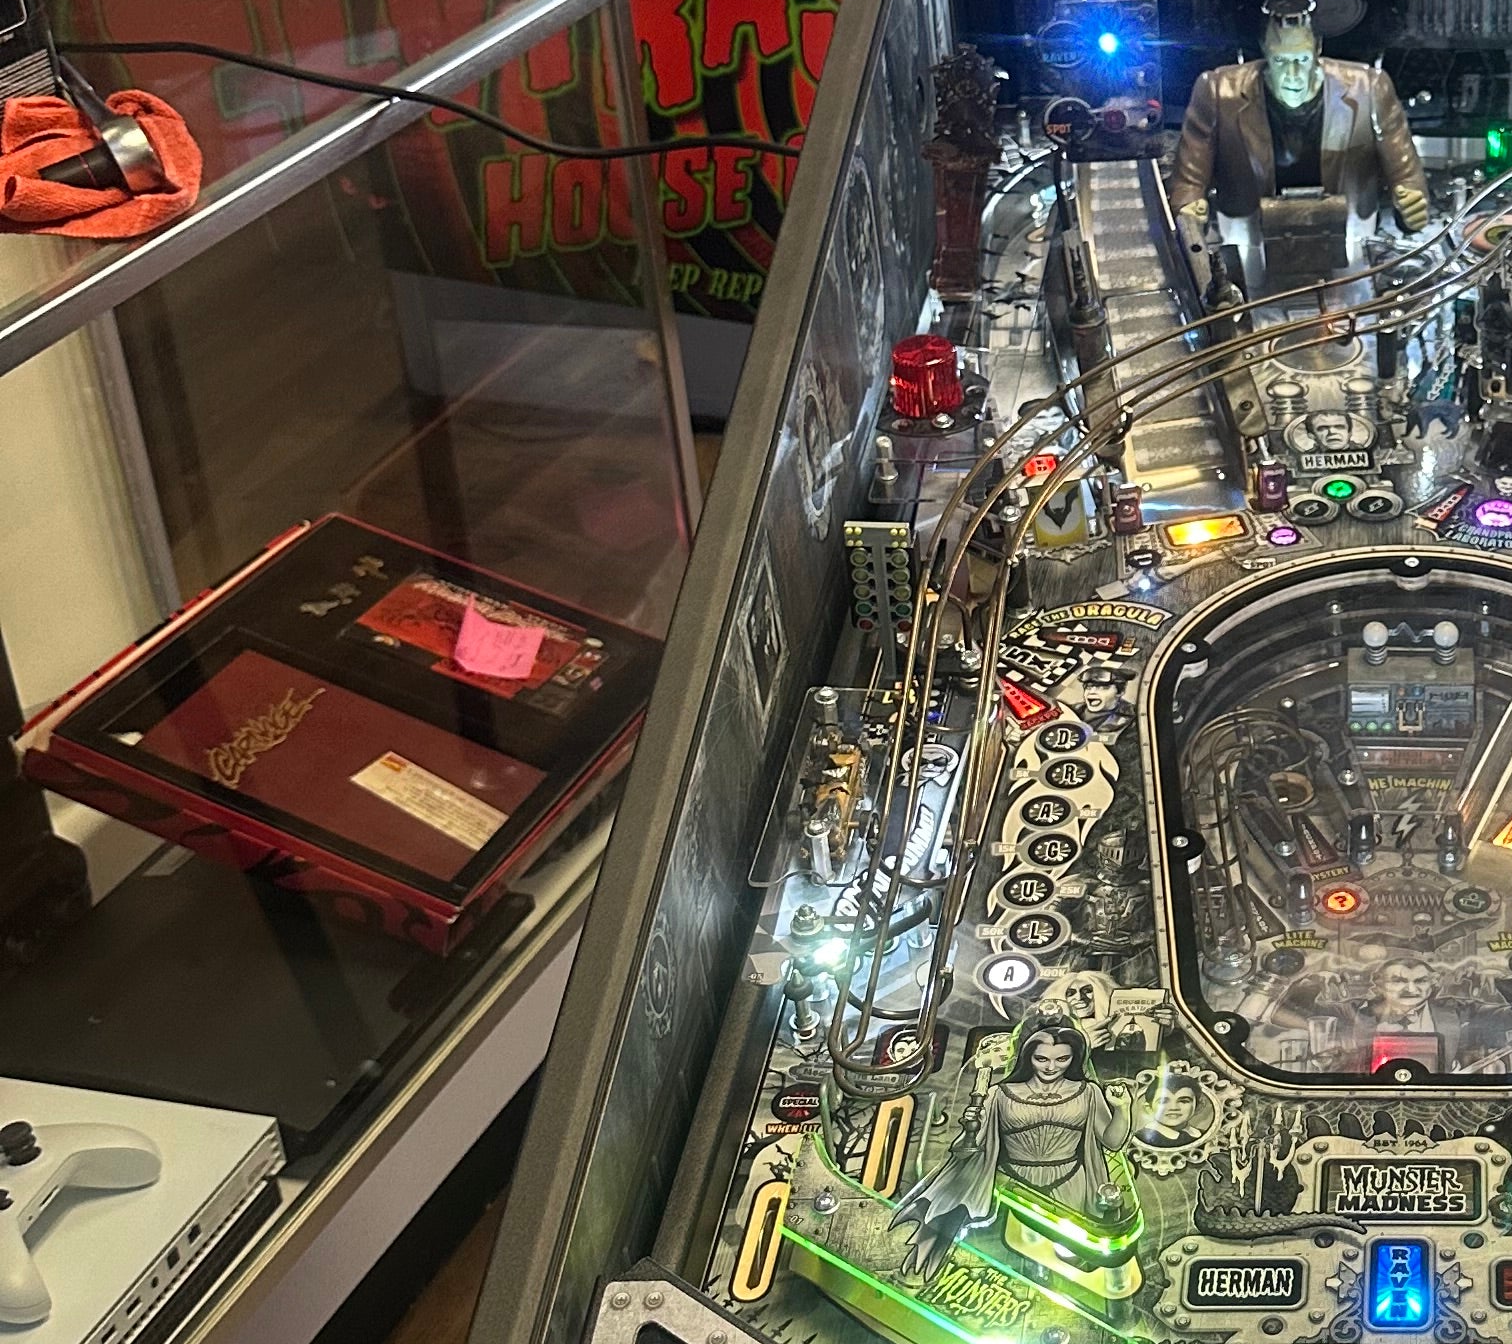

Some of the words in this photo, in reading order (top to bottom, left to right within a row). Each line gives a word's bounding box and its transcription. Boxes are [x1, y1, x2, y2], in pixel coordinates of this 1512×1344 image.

[484, 145, 755, 266] HOUSE
[1303, 452, 1369, 469] HERMAN
[1042, 611, 1071, 624] THE
[205, 688, 326, 790] CARNAGE
[1057, 729, 1070, 748] D
[1064, 763, 1078, 785] R
[1037, 802, 1056, 822] A
[1047, 840, 1061, 862] G
[1021, 880, 1039, 900] U
[1029, 920, 1045, 942] L
[1285, 929, 1315, 941] LITE
[1273, 938, 1328, 951] MACHINE
[1003, 965, 1016, 984] A
[779, 1096, 820, 1109] SPECIAL
[766, 1124, 798, 1135] WHEN
[800, 1123, 820, 1134] LIT
[1340, 1164, 1463, 1197] MUNSTER
[1336, 1193, 1467, 1214] MADNESS
[984, 1267, 1009, 1286] THE
[1198, 1267, 1294, 1297] HERMAN
[930, 1262, 1031, 1328] MUNSTERS
